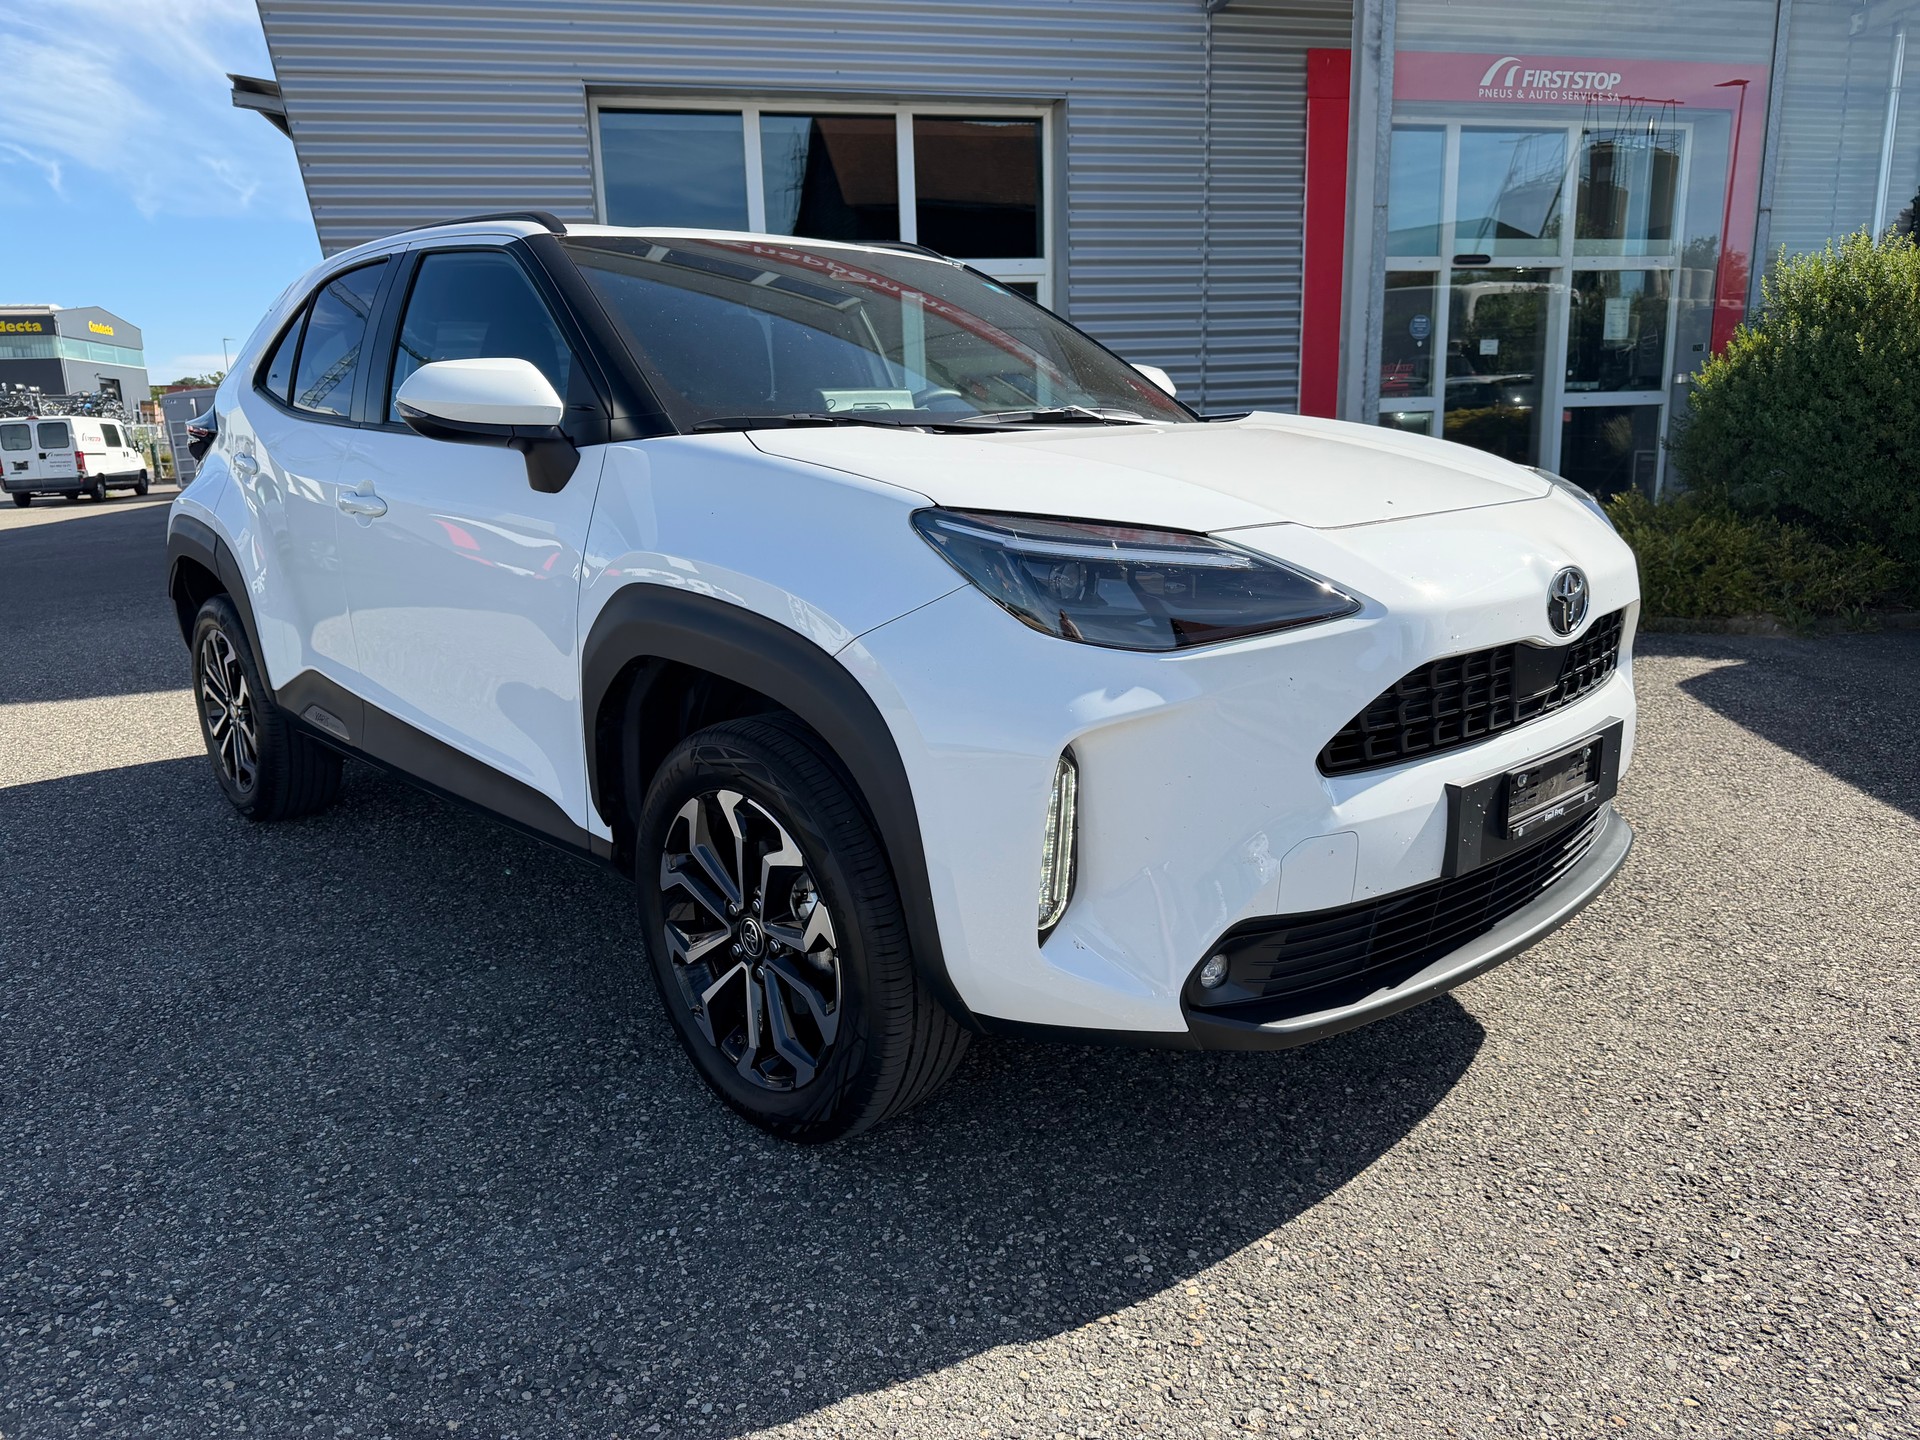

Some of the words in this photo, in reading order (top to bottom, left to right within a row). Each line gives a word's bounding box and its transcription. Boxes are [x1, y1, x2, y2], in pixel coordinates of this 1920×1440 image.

[1478, 88, 1512, 98] PNEUS
[1516, 89, 1524, 99] &
[1528, 90, 1558, 100] AUTO
[1562, 91, 1603, 101] SERVICE
[1607, 92, 1620, 101] SA
